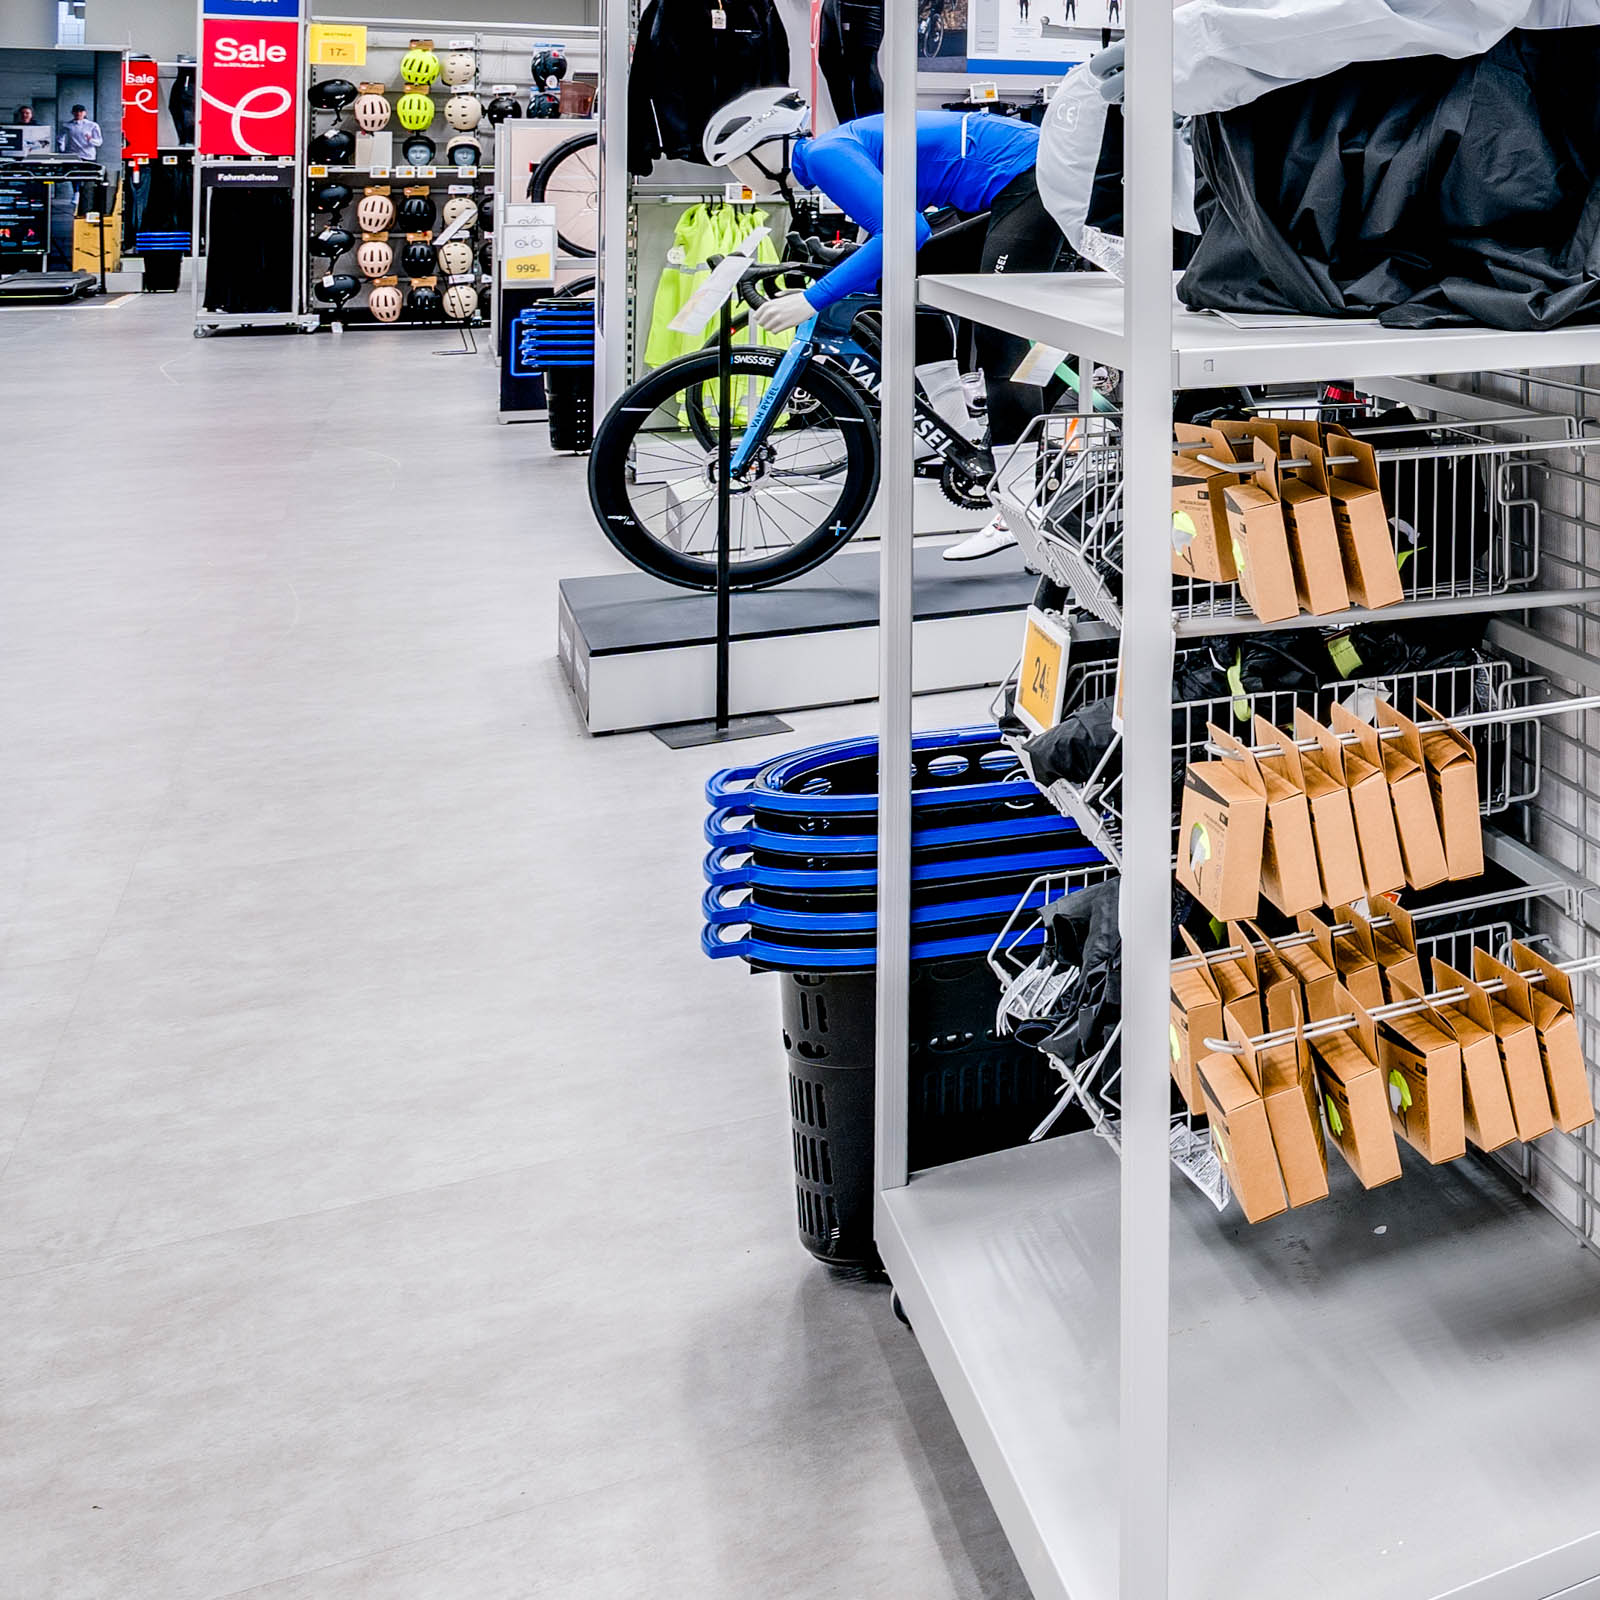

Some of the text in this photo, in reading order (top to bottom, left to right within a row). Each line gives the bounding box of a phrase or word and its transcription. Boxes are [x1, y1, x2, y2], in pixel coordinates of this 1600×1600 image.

[213, 37, 287, 63] Sale
[125, 72, 156, 85] Sale
[750, 386, 779, 429] VAN RYSEL
[913, 406, 955, 458] YSEL
[1032, 656, 1047, 700] 24
